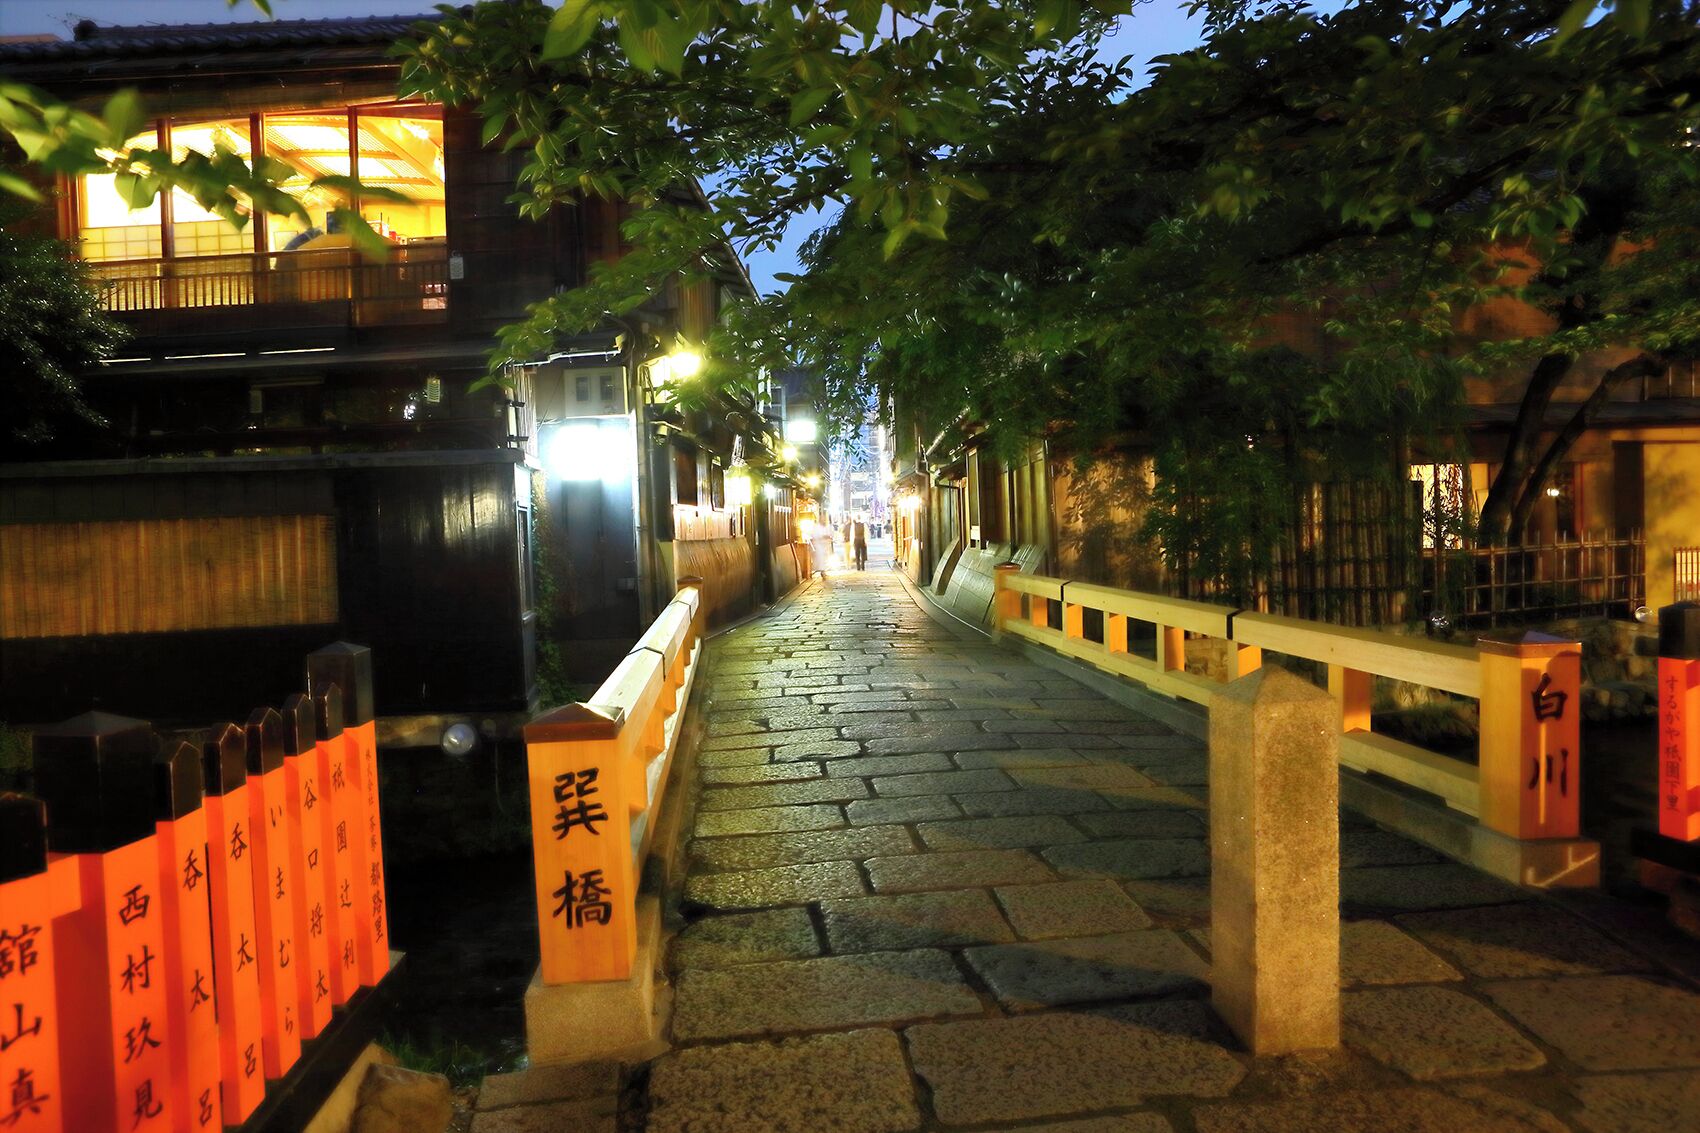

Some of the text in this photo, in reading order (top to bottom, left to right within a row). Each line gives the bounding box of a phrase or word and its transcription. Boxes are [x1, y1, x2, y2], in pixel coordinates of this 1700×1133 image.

[552, 767, 612, 930] 巽橋
[1528, 672, 1569, 798] 白川
[230, 821, 257, 1080] 呑太呂
[270, 803, 296, 1037] いまむら
[303, 778, 330, 1005] 谷口将太
[331, 762, 356, 970] 祇園辻利
[182, 849, 213, 1128] 呑太呂
